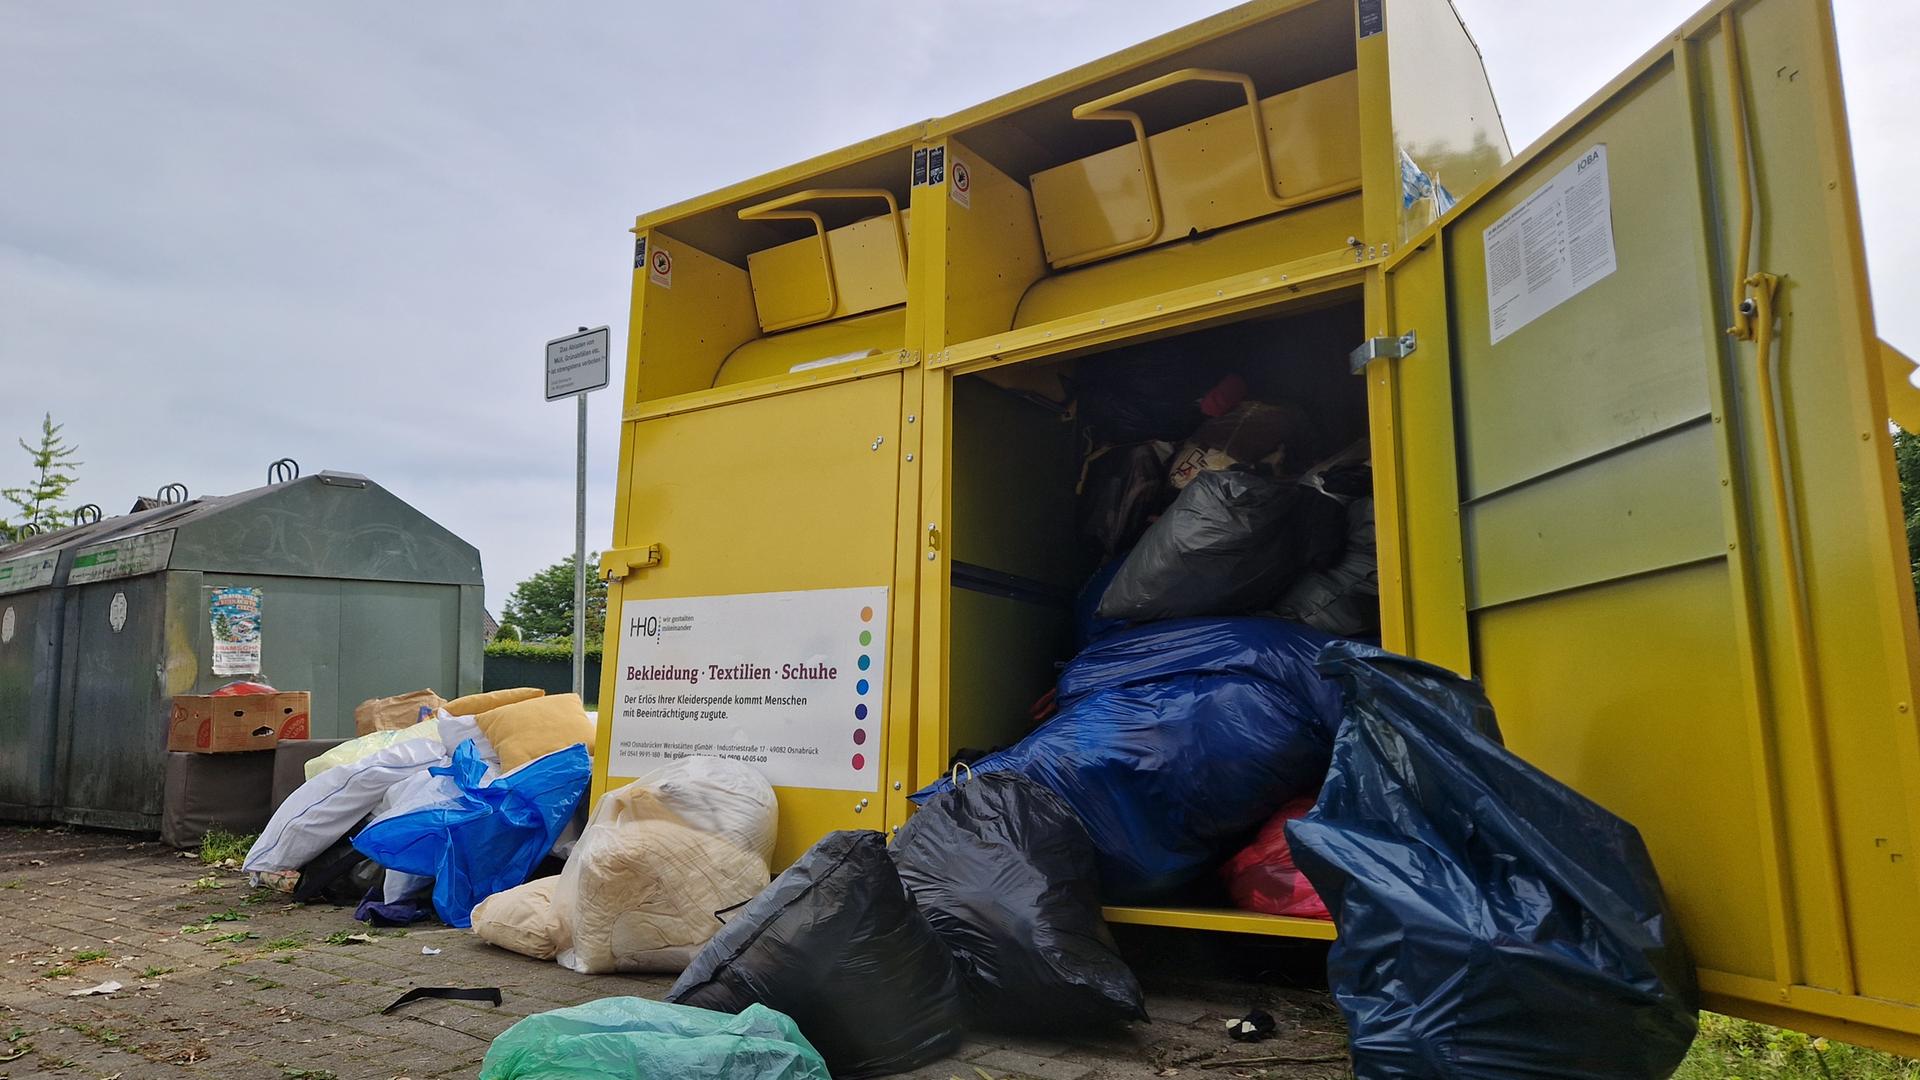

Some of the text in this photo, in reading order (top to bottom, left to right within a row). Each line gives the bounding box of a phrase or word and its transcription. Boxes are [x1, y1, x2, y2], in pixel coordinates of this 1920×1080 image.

[1577, 151, 1599, 173] JOBA
[671, 615, 694, 623] gestalten
[630, 616, 657, 637] HHO
[626, 663, 837, 684] Bekleidung Textilien Schuhe
[624, 694, 807, 707] Der Erlös Ihrer Kleiderspende kommt Menschen
[622, 707, 729, 721] mit Beeinträchtigung zugute.
[632, 741, 662, 749] Osnabrücker
[663, 742, 693, 750] Werkstätten
[716, 744, 758, 752] Industriestraße
[787, 746, 819, 755] Osnabrück
